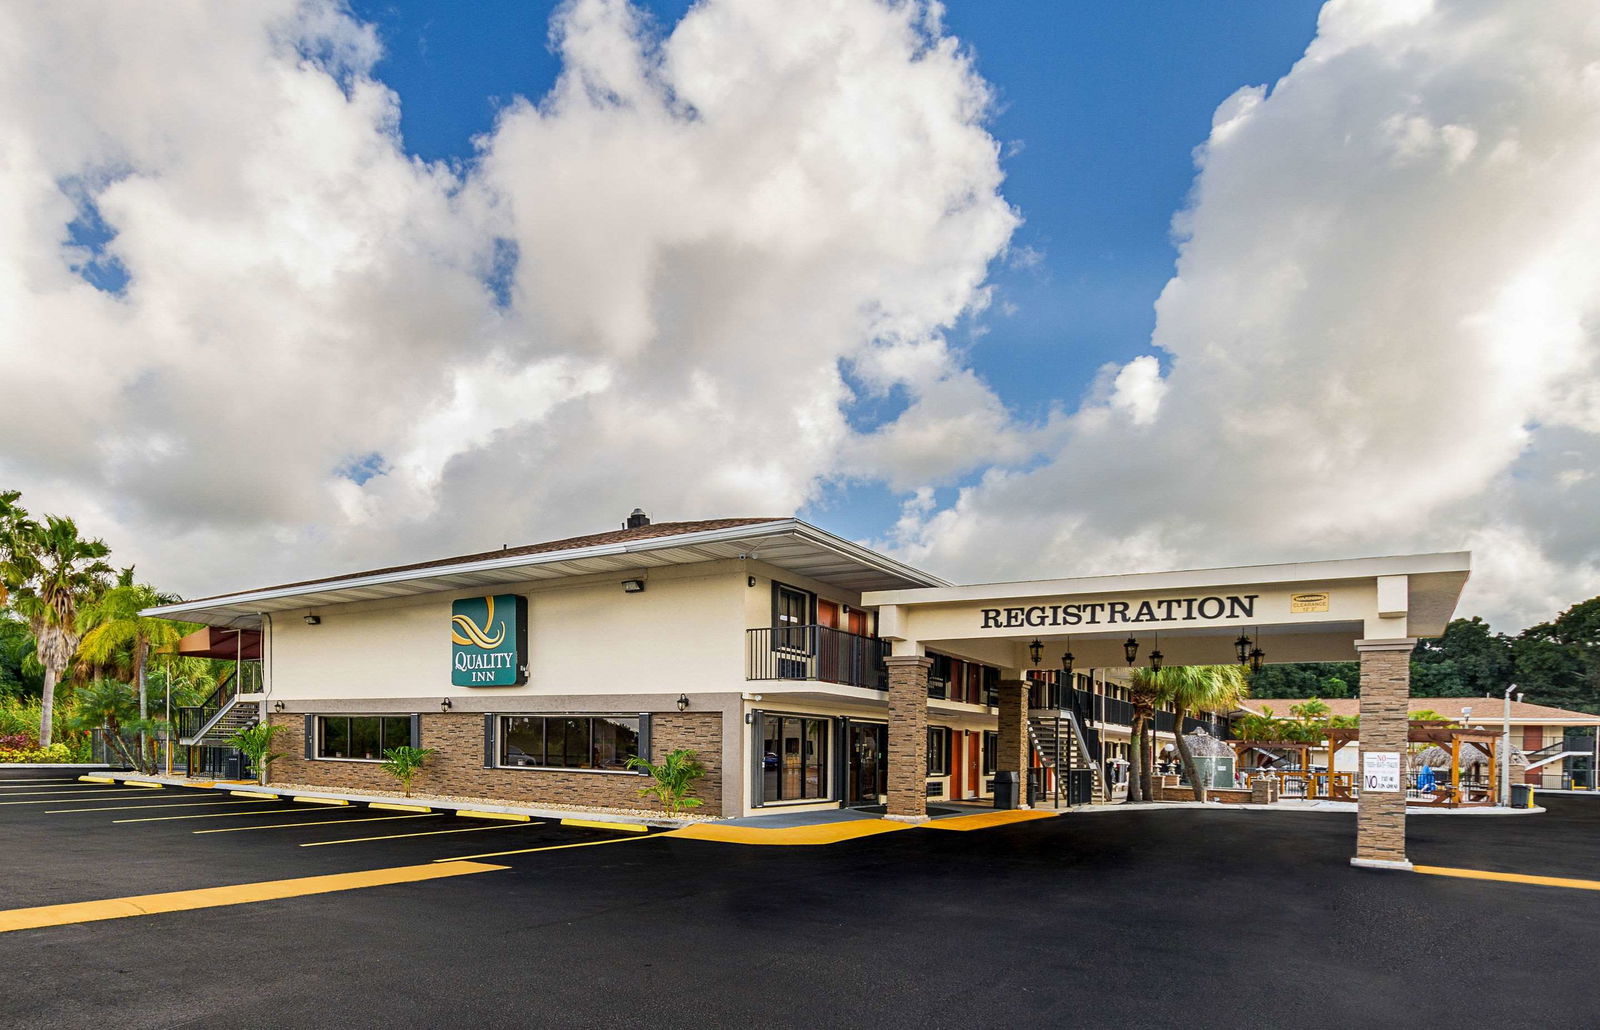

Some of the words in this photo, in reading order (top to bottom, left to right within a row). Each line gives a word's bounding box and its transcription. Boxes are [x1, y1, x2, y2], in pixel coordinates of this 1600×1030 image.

[980, 594, 1259, 629] REGISTRATION
[455, 651, 513, 672] QUALITY
[471, 671, 496, 682] INN
[1365, 775, 1377, 789] NO
